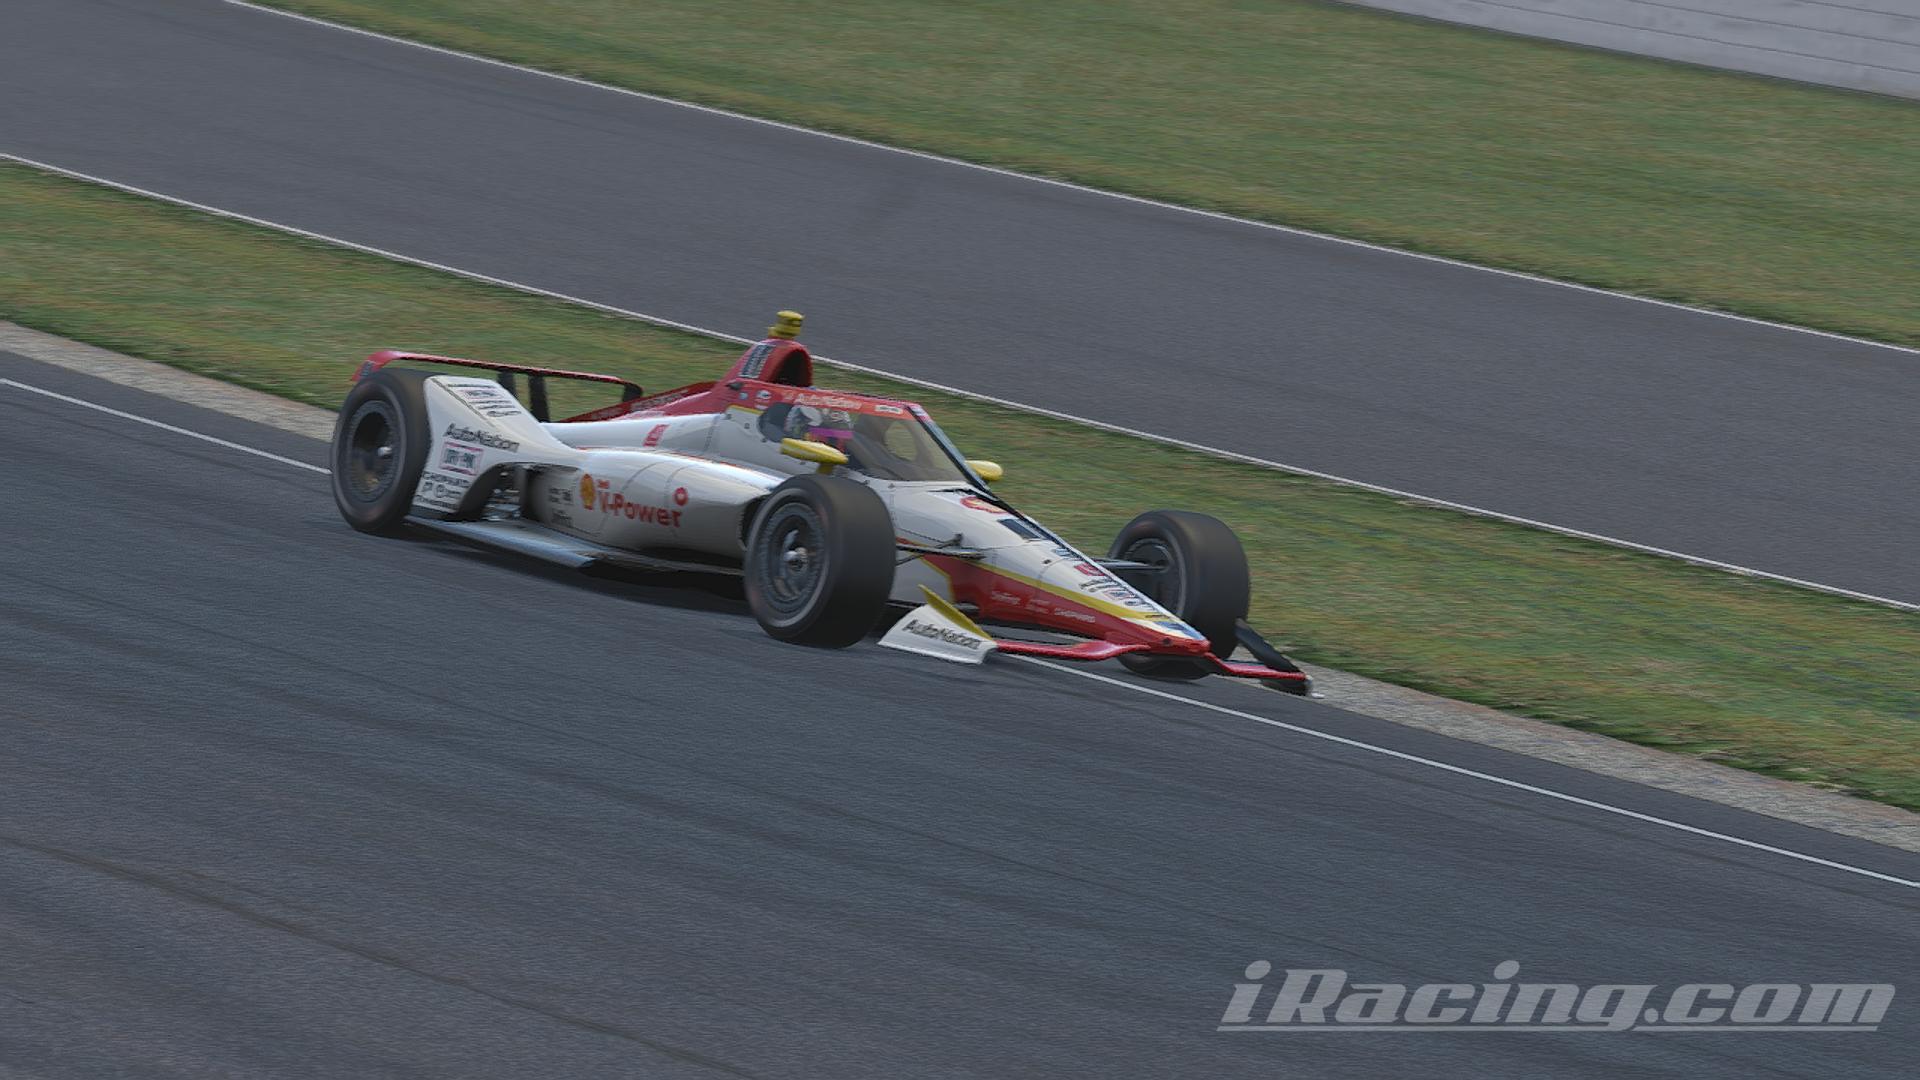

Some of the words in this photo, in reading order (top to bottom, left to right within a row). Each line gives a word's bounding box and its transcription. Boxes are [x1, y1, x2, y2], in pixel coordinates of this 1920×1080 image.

[443, 423, 520, 453] AutoNation
[597, 491, 683, 529] V-Power
[902, 619, 982, 650] AutoNation
